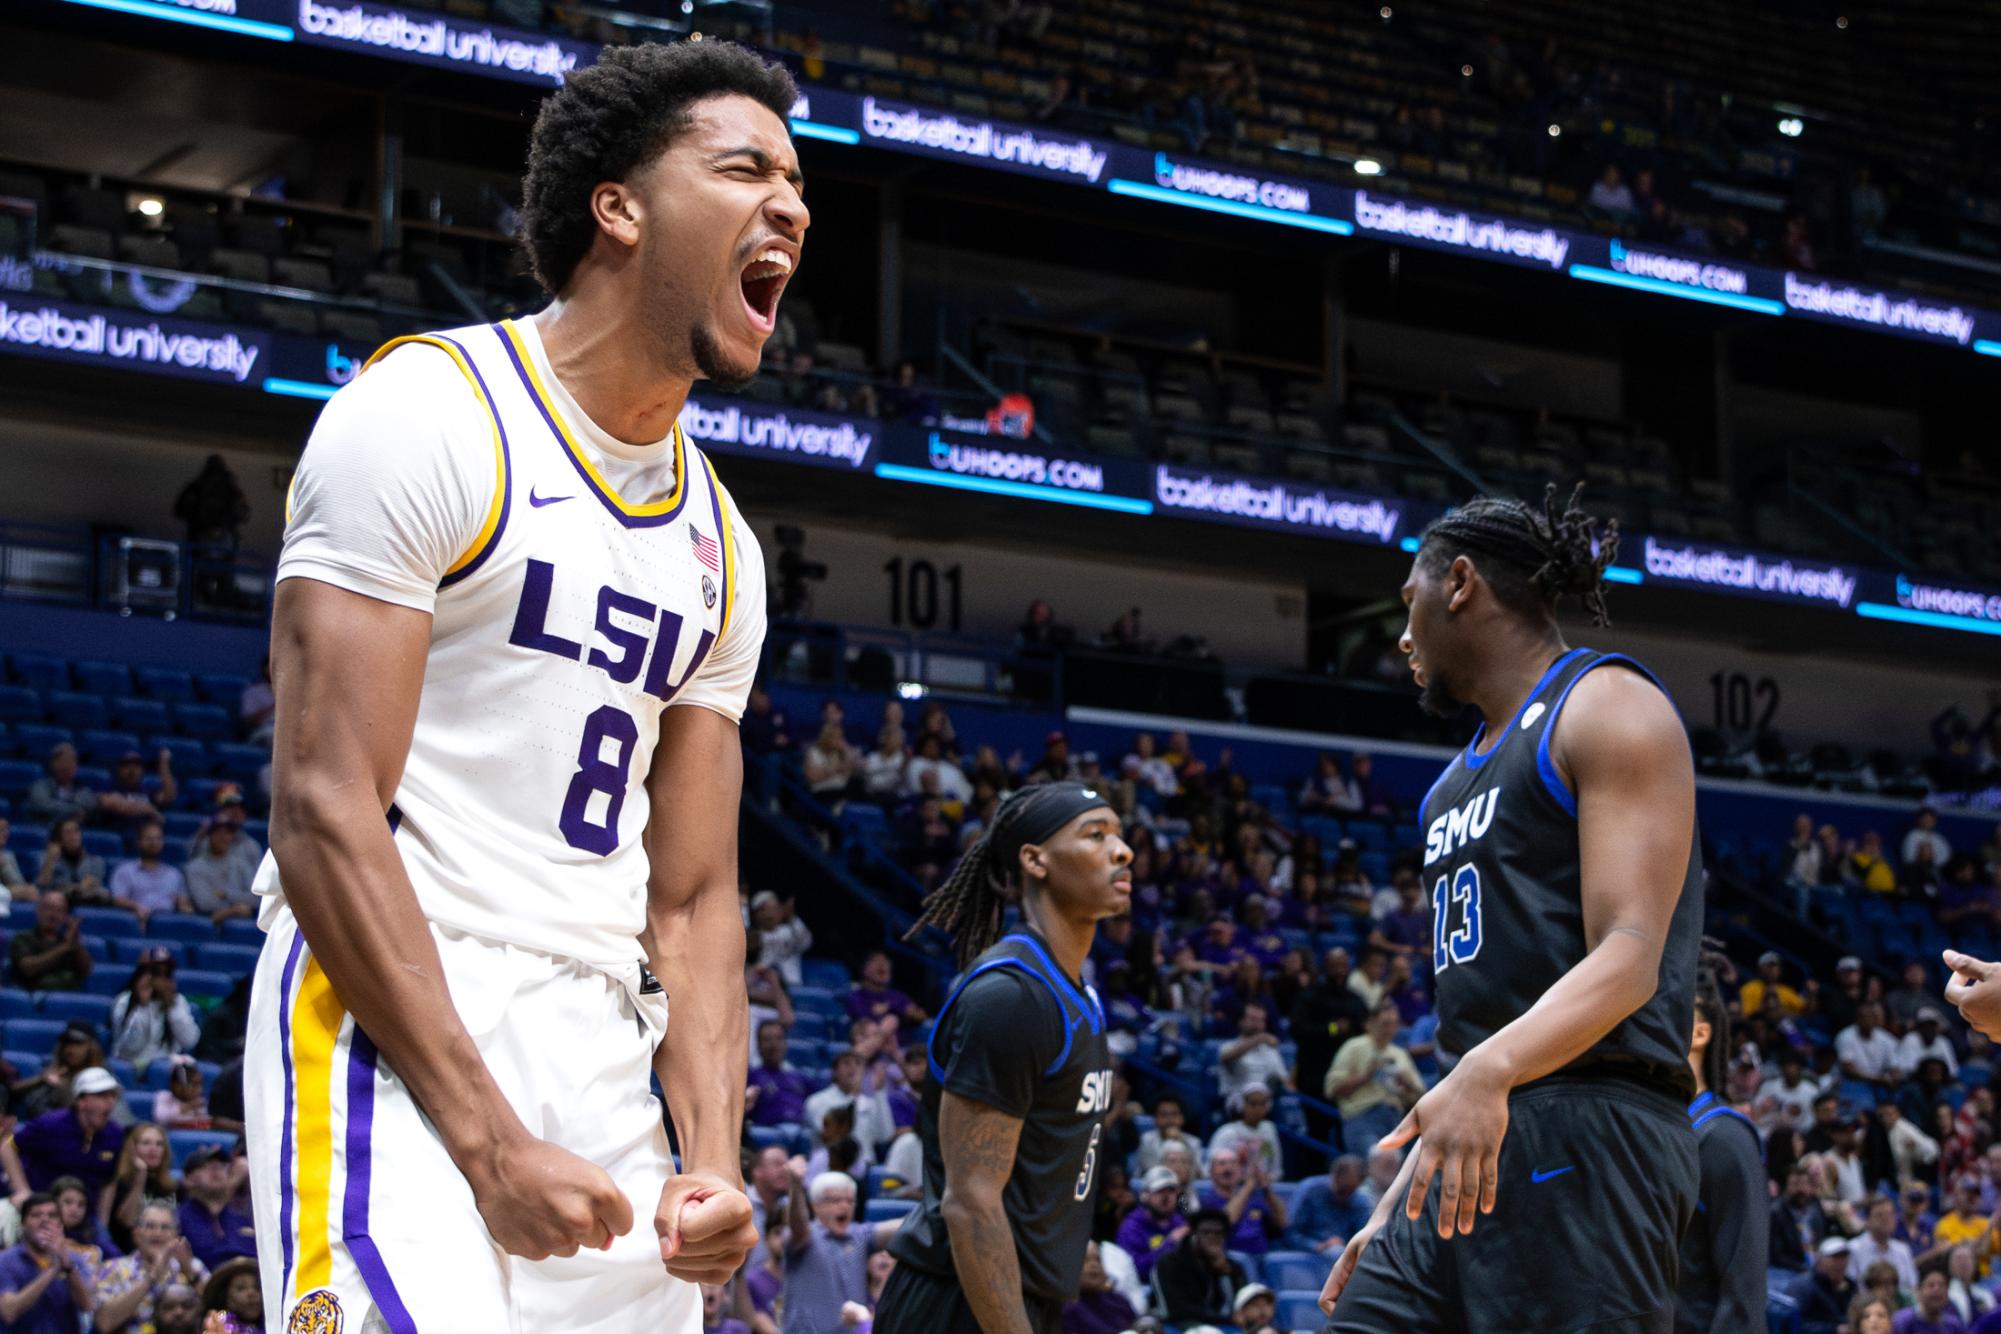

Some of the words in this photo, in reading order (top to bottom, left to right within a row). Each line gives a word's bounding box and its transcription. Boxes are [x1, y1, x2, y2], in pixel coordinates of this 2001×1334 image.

[299, 0, 446, 55] basketball
[447, 30, 577, 86] university
[863, 97, 993, 156] basketball
[993, 131, 1106, 182] university
[1355, 190, 1468, 245] basketball
[106, 323, 258, 382] university
[741, 413, 872, 467] university
[1157, 464, 1285, 520] basketball
[1285, 492, 1398, 542] university
[883, 556, 962, 632] 101
[1645, 537, 1755, 587] basketball
[508, 558, 717, 703] LSU
[1709, 670, 1780, 735] 102
[559, 704, 638, 858] 8
[1424, 786, 1500, 867] SMU
[1433, 862, 1482, 975] 13
